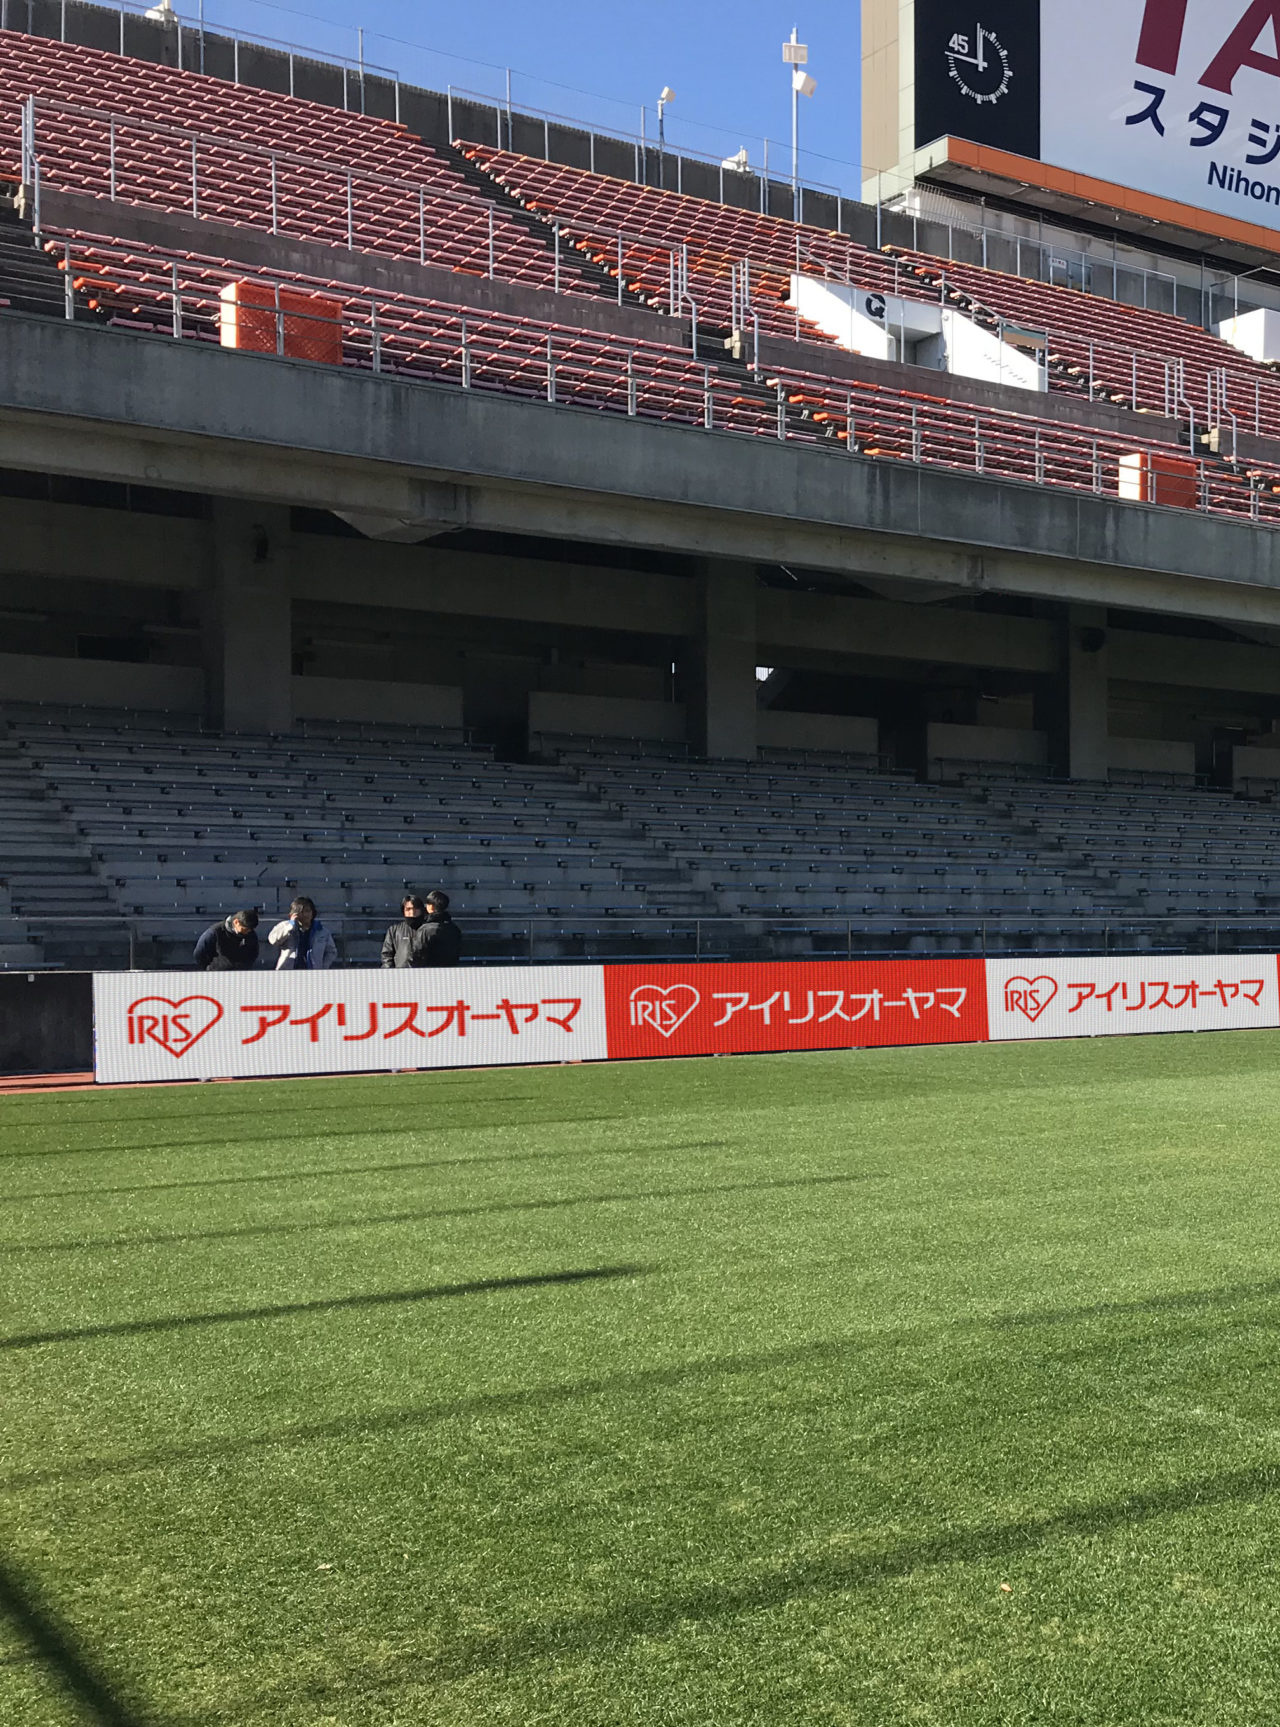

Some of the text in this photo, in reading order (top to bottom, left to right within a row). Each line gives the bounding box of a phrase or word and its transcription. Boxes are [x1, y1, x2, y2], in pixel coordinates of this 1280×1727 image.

[948, 33, 969, 54] 45
[865, 293, 886, 319] Q
[713, 988, 966, 1026] アイリスオーヤマ
[1067, 980, 1264, 1013] アイリスオーヤマ
[240, 998, 581, 1044] アイリスオーヤマ
